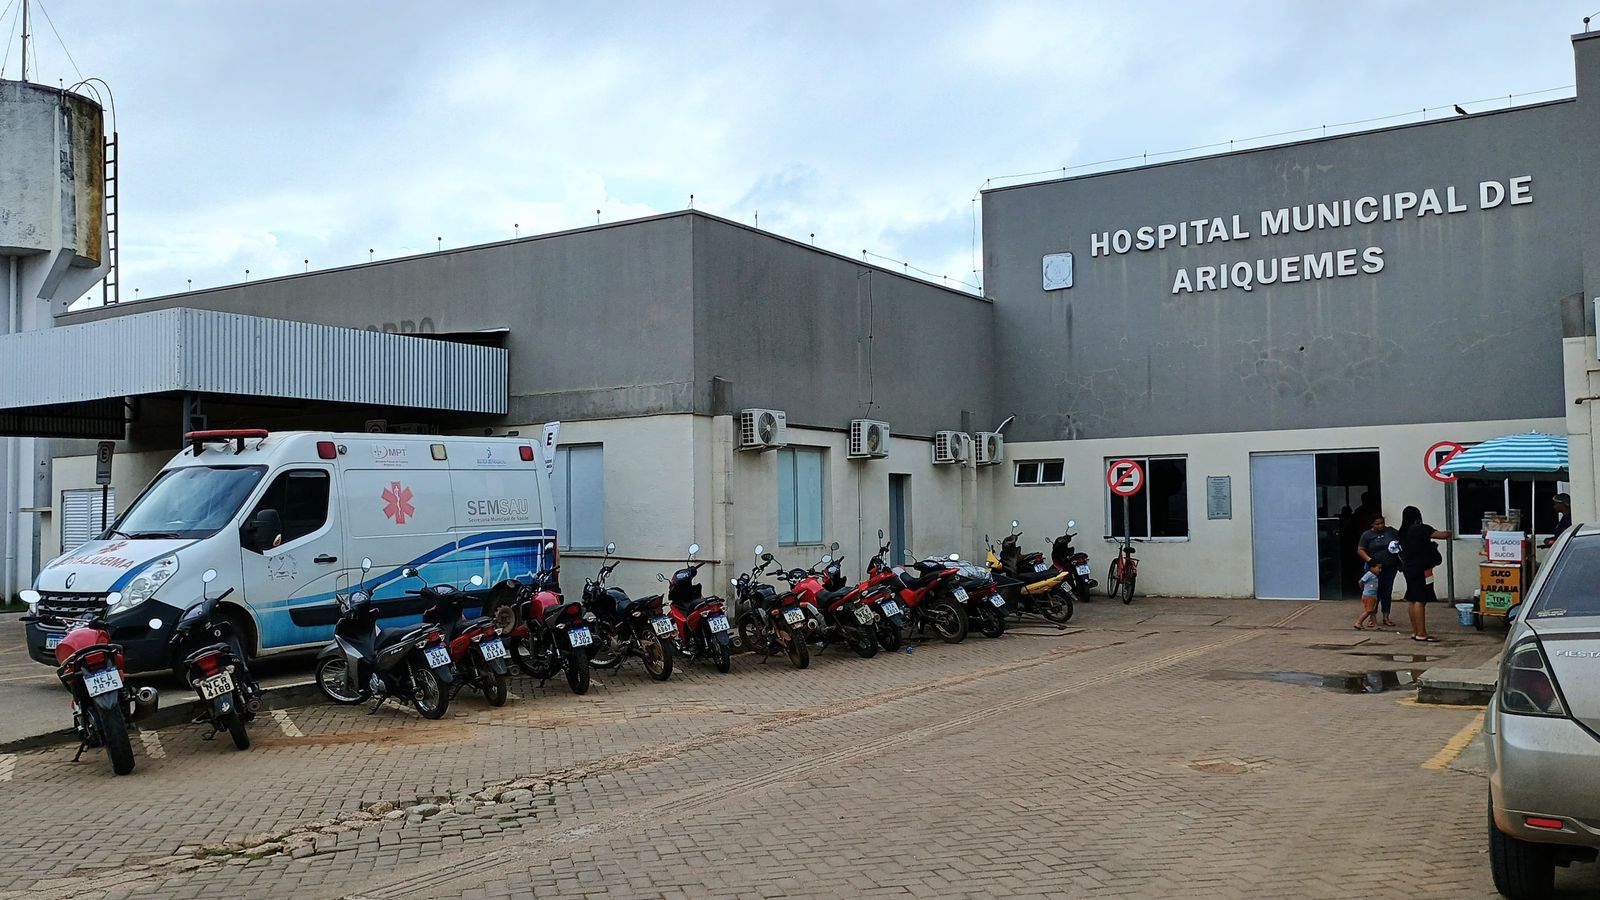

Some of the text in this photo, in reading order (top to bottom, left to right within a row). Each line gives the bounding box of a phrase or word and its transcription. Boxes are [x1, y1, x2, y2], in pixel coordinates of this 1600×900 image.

[1090, 175, 1534, 257] HOSPITAL MUNICIPAL DE
[1172, 246, 1386, 294] ARIQUEMES
[547, 432, 553, 446] E
[101, 448, 107, 460] E
[388, 448, 407, 457] MPT
[1116, 467, 1133, 486] E
[467, 499, 529, 515] SEMSAU
[1481, 585, 1519, 593] LARANJA
[431, 649, 444, 659] SLL
[92, 680, 118, 694] 2875
[206, 677, 227, 690] NCR
[207, 683, 231, 697] 4188
